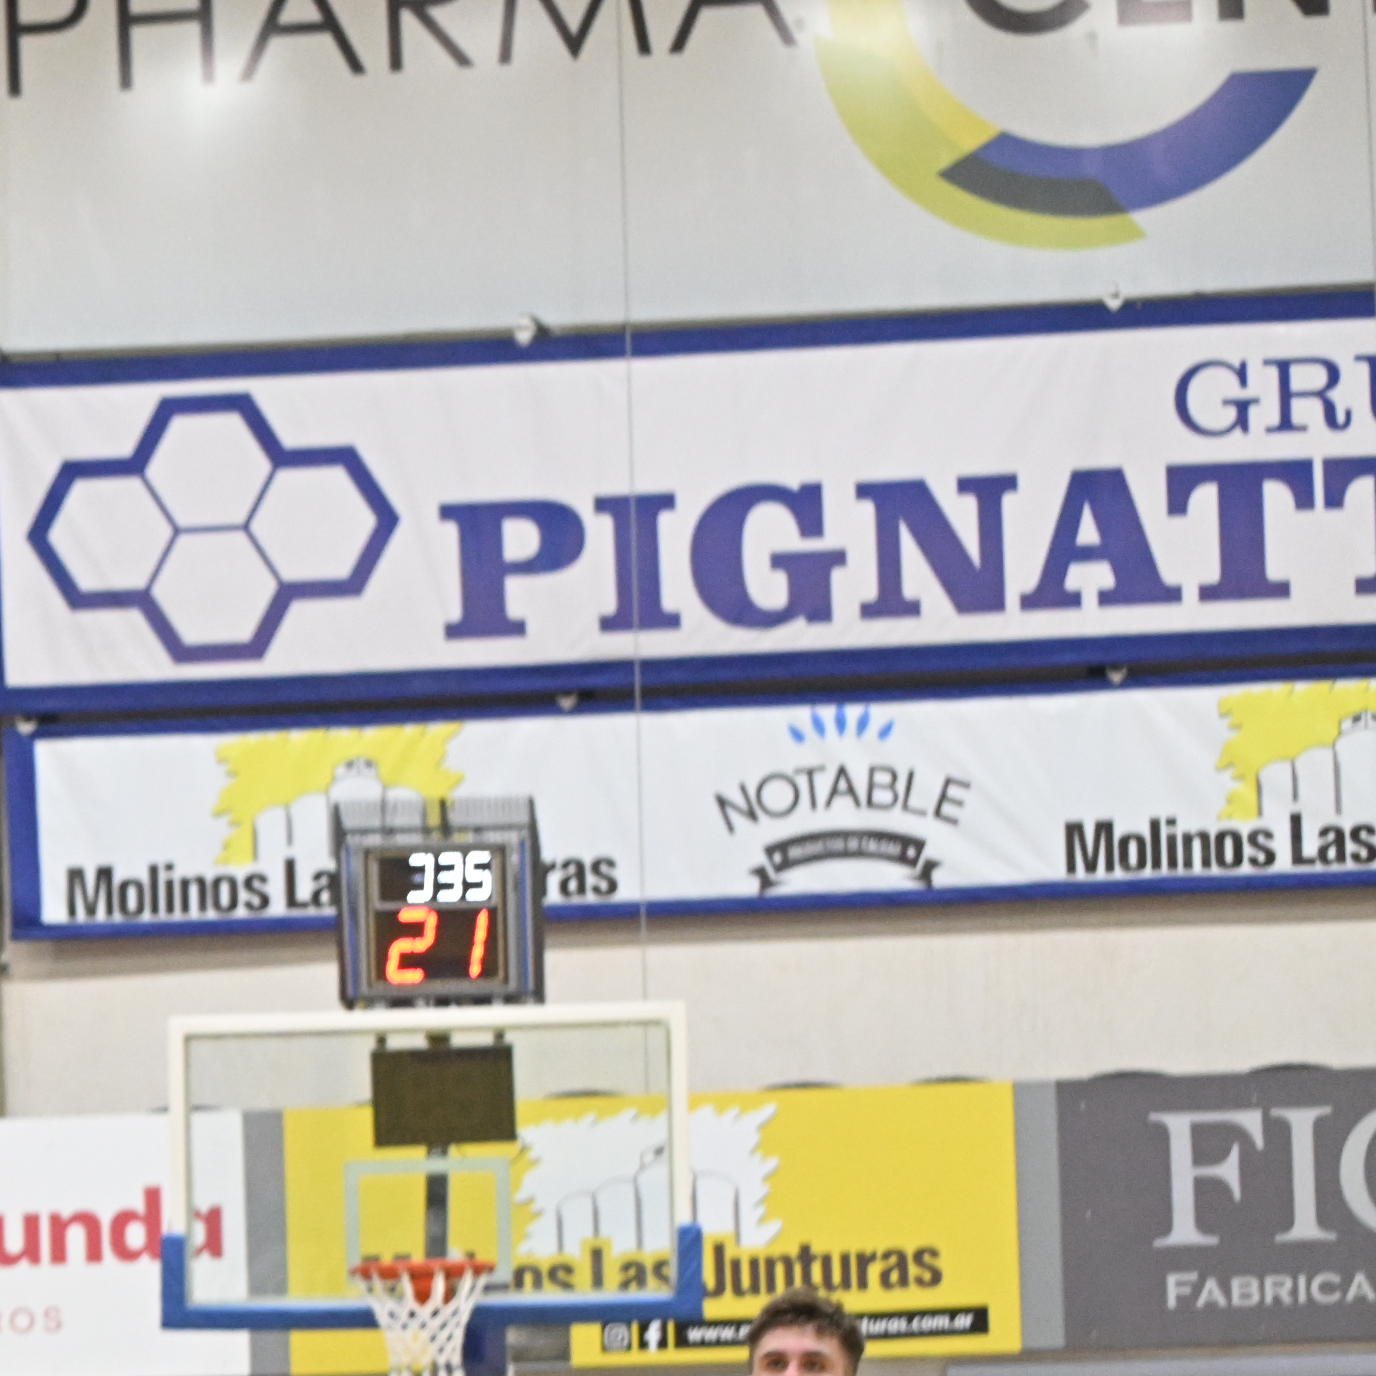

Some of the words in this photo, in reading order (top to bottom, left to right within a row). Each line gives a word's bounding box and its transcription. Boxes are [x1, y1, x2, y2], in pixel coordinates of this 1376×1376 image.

[1174, 354, 1376, 438] GR
[714, 763, 972, 836] NOTABLE
[1064, 815, 1277, 875] Molinos
[1289, 811, 1376, 867] Las
[66, 864, 271, 920] Molinos
[285, 857, 335, 911] La
[385, 905, 490, 985] 21
[702, 1242, 943, 1298] Junturas
[1165, 1270, 1376, 1311] FABRICA
